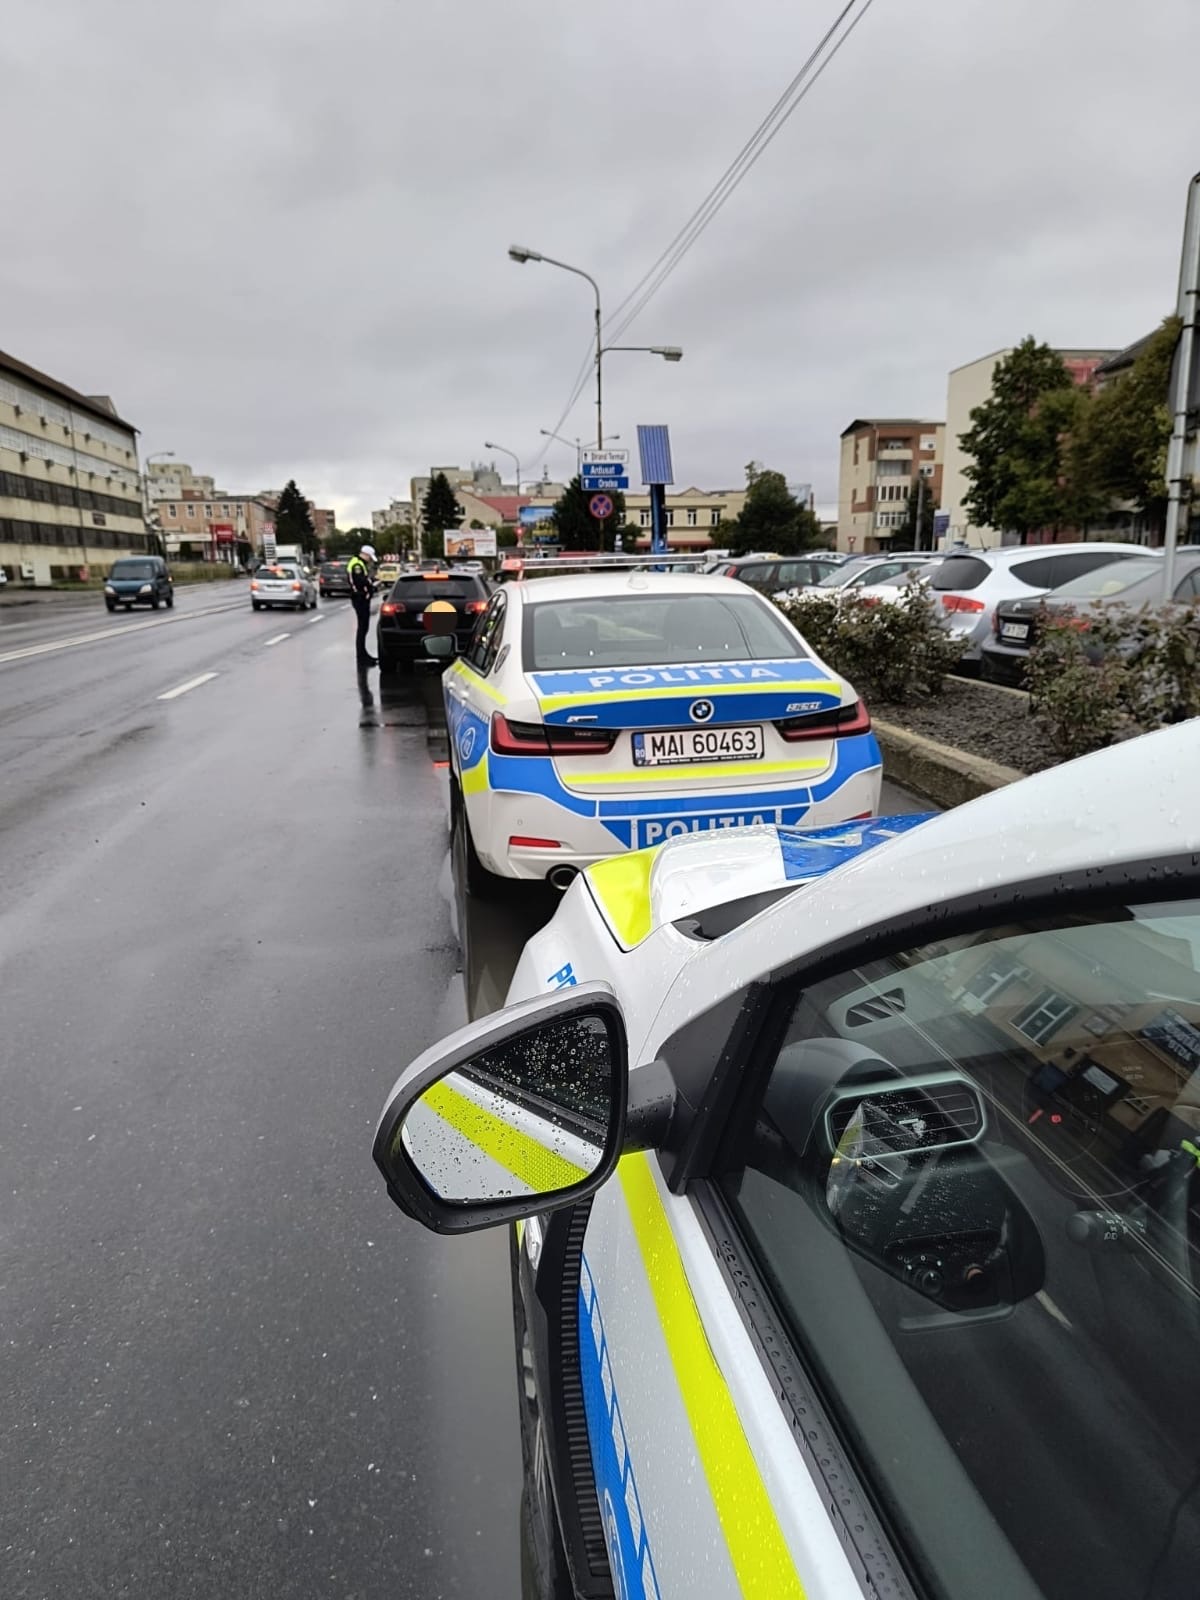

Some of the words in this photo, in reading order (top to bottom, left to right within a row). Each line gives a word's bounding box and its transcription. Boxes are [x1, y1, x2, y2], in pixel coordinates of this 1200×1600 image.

[588, 667, 783, 688] POLITIA
[651, 733, 685, 757] MAI
[692, 730, 757, 754] 60463
